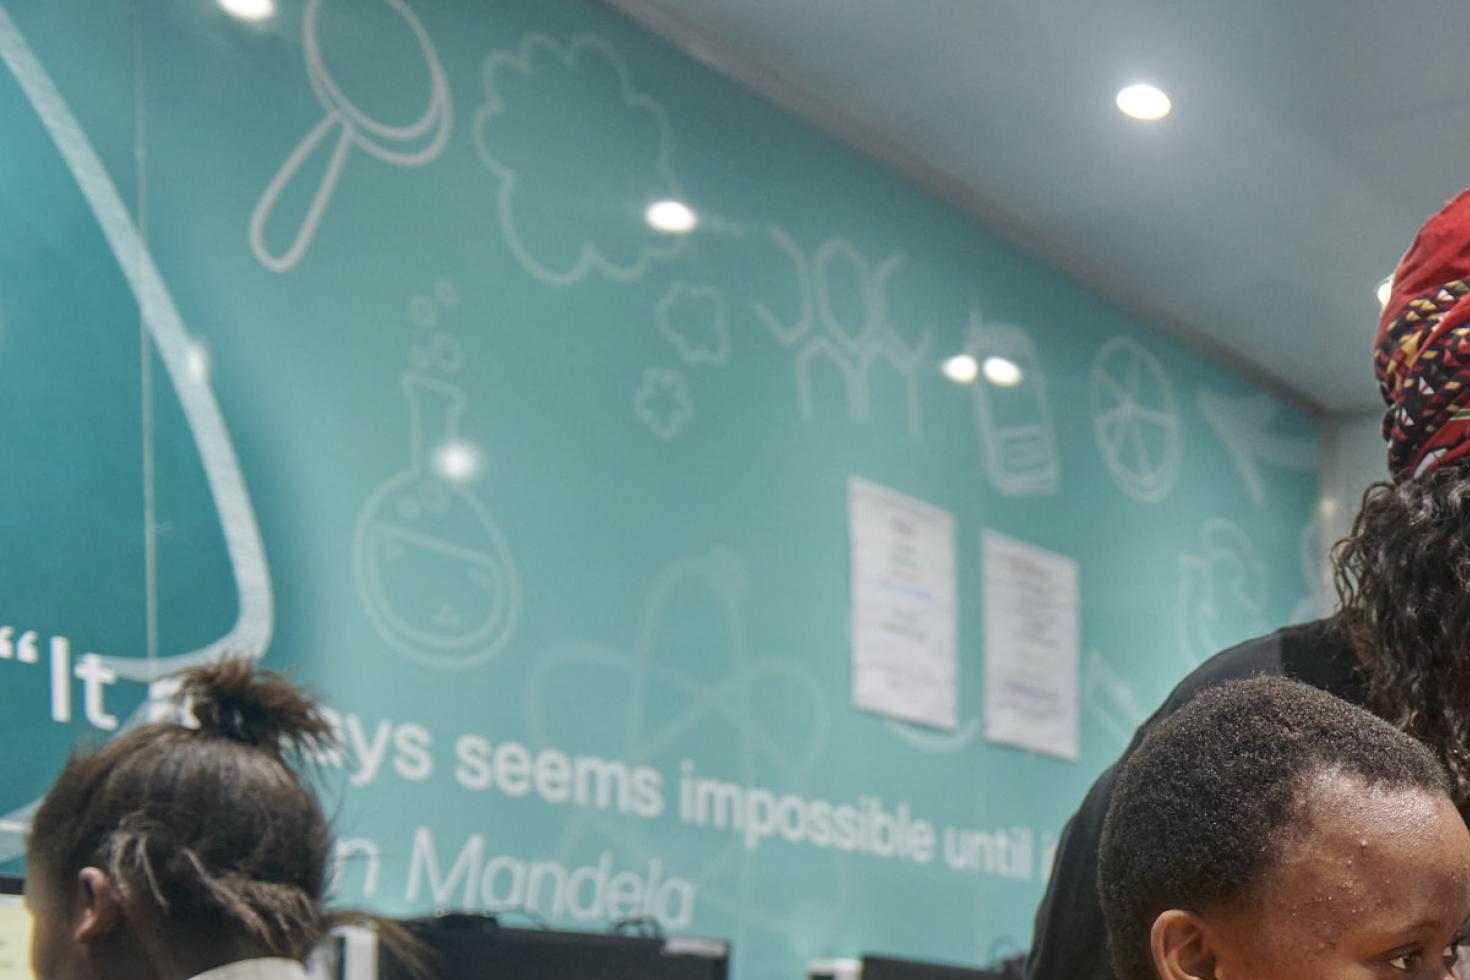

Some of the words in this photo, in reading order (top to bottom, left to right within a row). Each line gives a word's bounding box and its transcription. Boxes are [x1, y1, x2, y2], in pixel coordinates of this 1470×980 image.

[455, 733, 665, 818] seems
[680, 759, 935, 863] impossible
[944, 826, 1031, 879] until
[406, 826, 695, 929] Mandela
